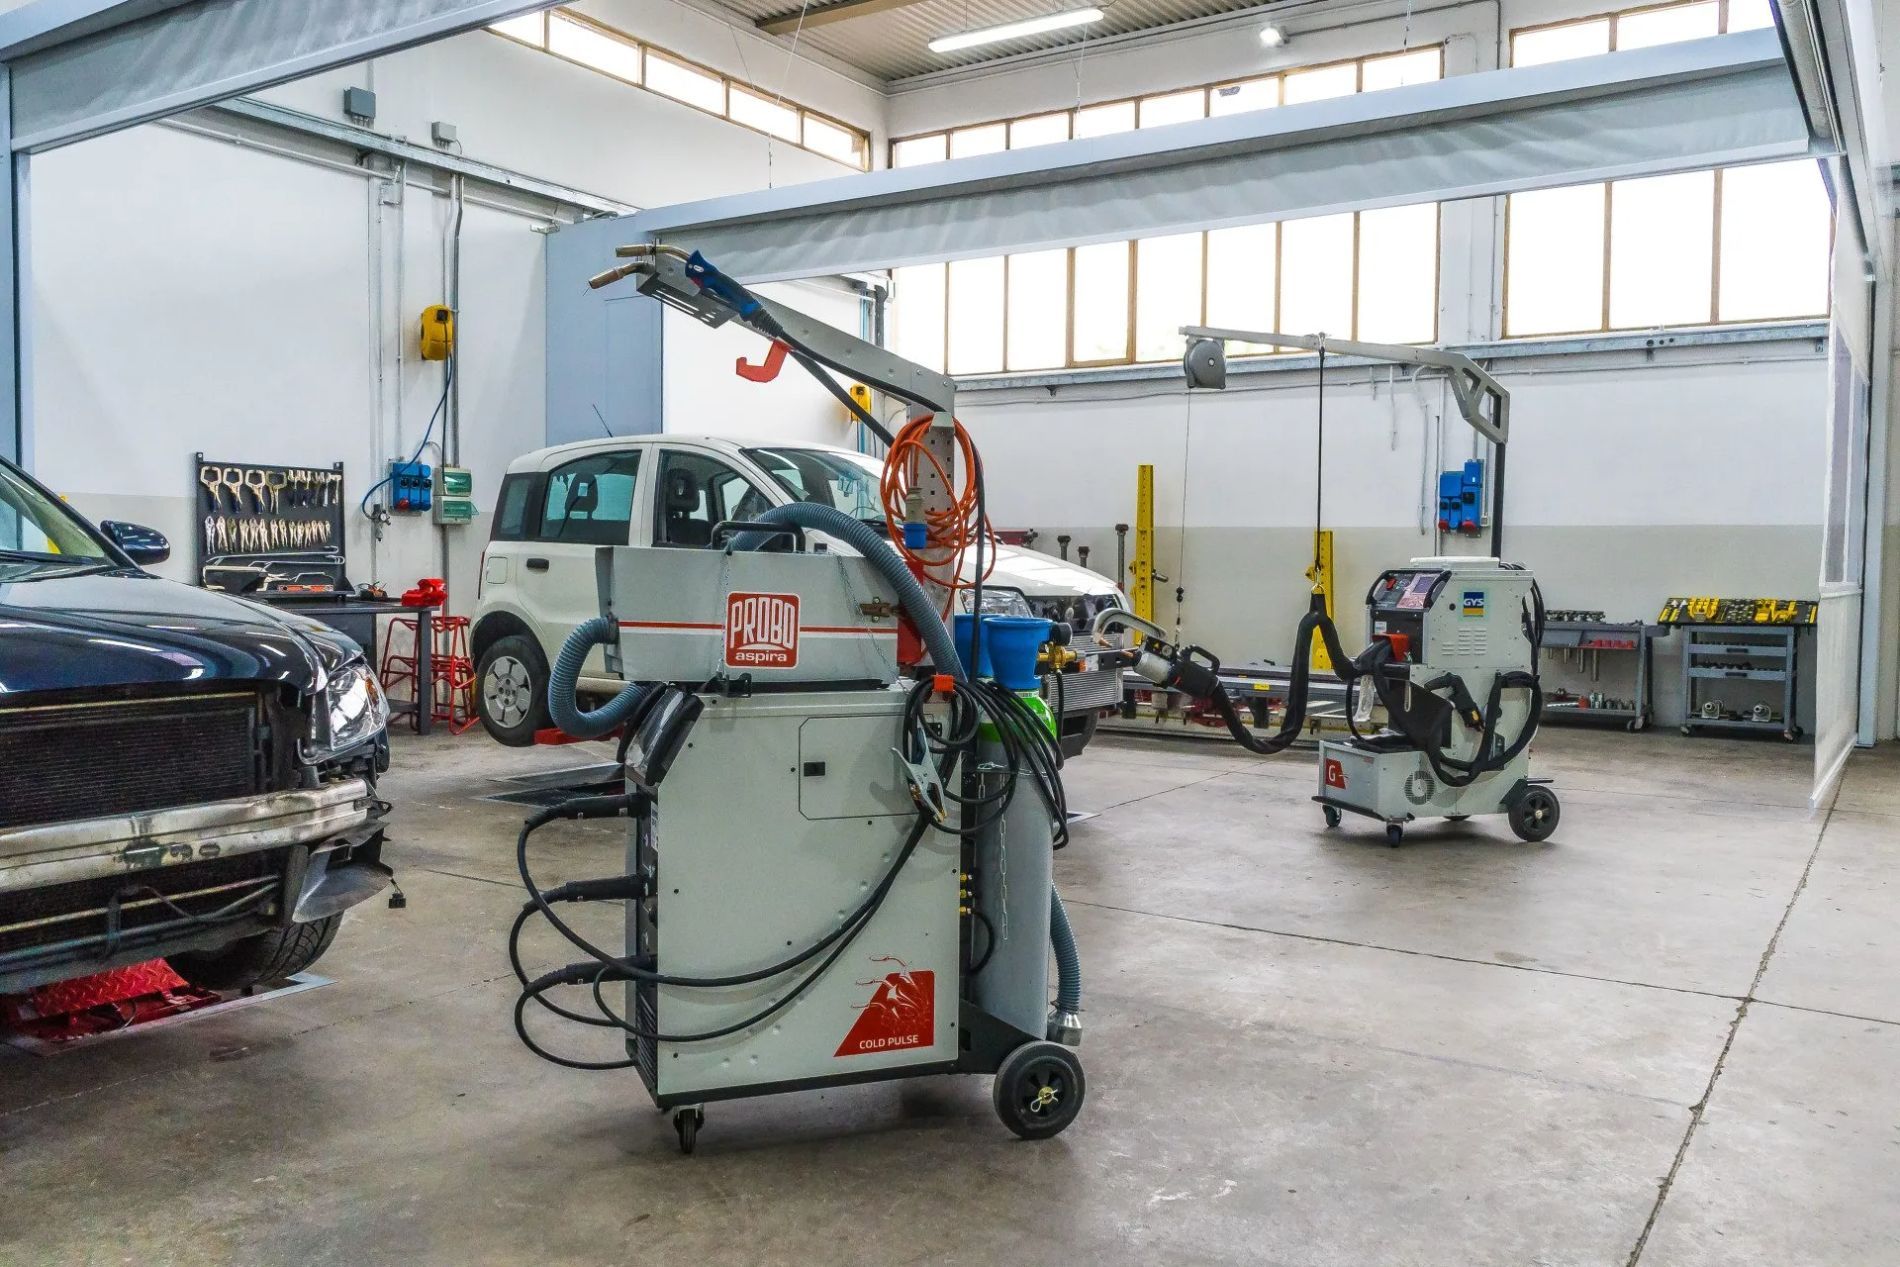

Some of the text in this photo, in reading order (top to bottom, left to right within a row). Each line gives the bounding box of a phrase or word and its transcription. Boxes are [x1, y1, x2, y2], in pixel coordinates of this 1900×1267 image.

[1463, 598, 1484, 606] GYS
[730, 597, 796, 649] PROBO
[735, 650, 788, 664] aspira
[859, 1034, 919, 1050] COLD PULSE
